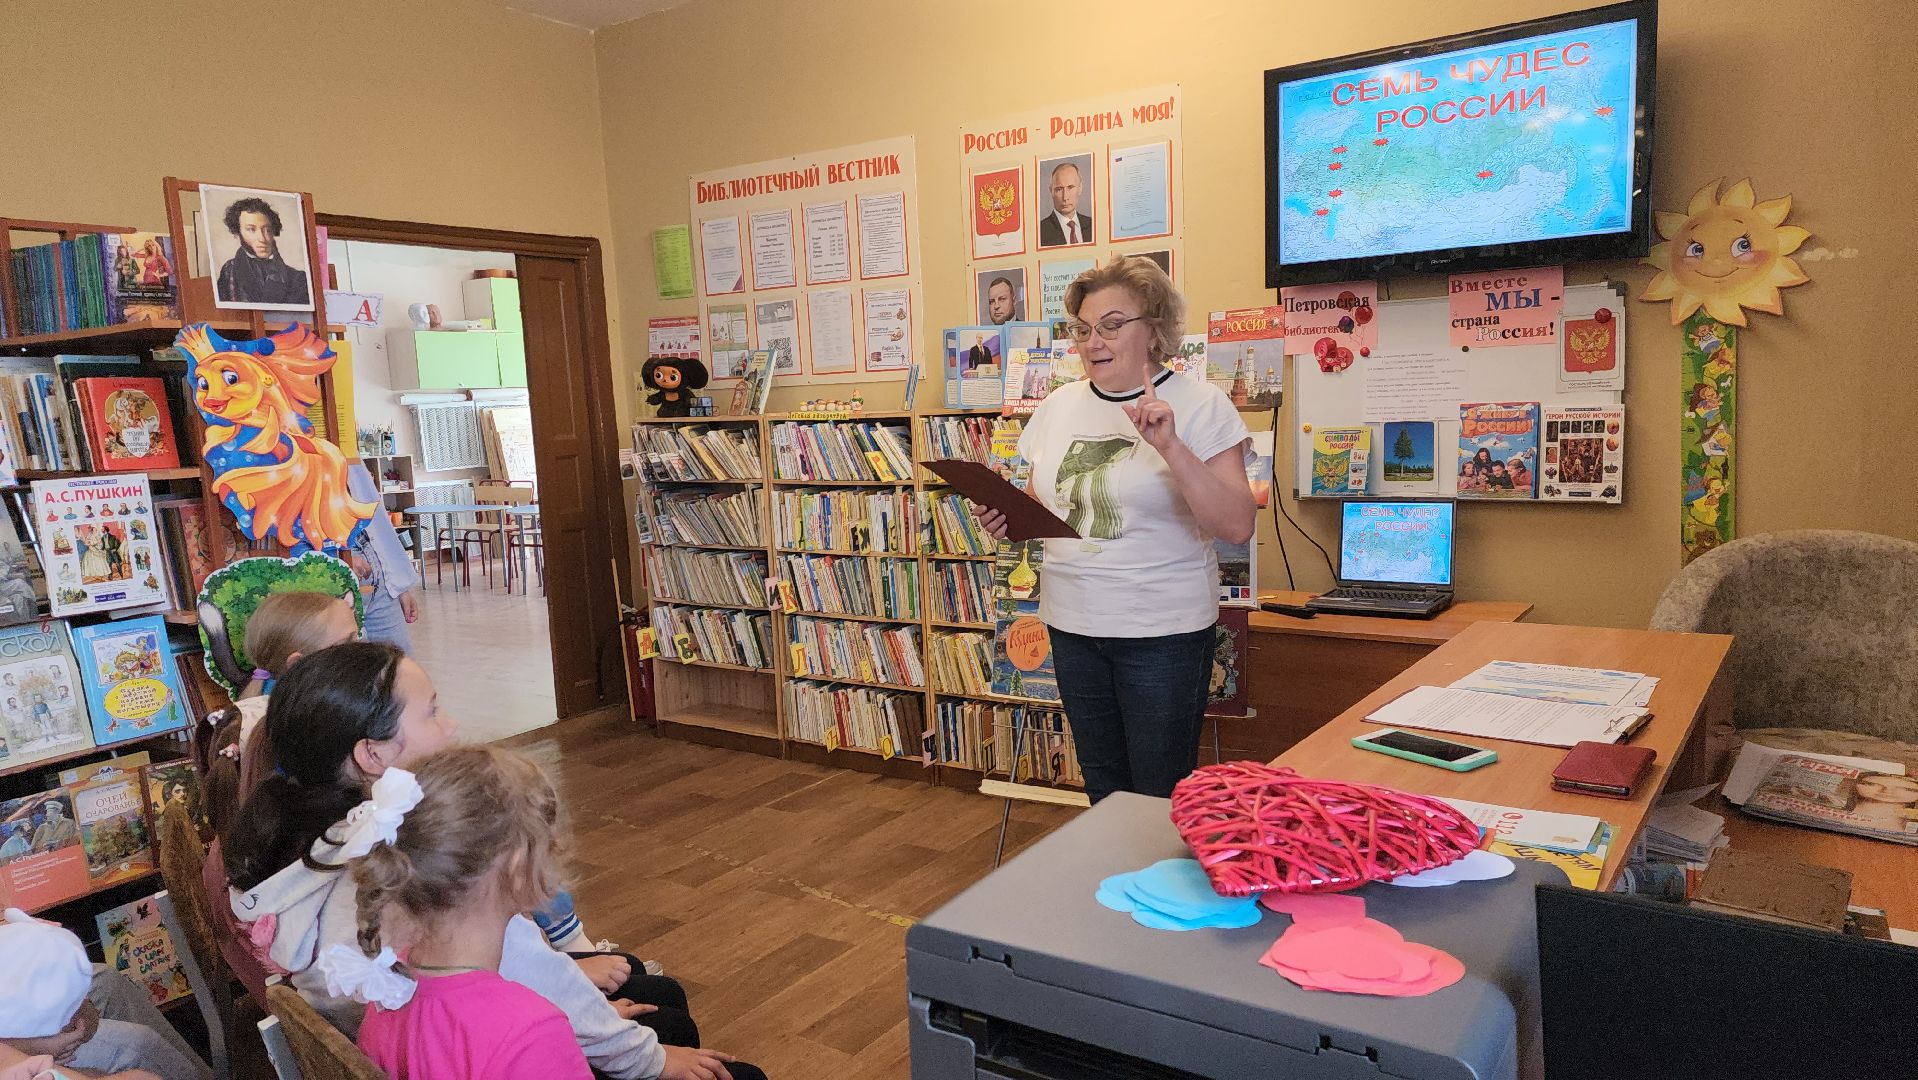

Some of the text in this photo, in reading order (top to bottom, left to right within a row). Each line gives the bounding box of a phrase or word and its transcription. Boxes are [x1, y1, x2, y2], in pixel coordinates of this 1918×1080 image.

[1331, 42, 1590, 107] СЕМЬ ЧУДЕС
[1376, 85, 1547, 132] РОССИИ
[1451, 277, 1528, 293] Вместе
[1284, 295, 1370, 316] Петровская
[1485, 288, 1543, 311] МЫ
[1226, 318, 1268, 333] РОССИЯ
[1284, 322, 1353, 337] библиотек
[1451, 315, 1500, 329] страна
[1476, 322, 1555, 341] Россия!
[1360, 507, 1395, 517] СЕМЬ
[96, 792, 128, 808] ОЧЕЙ
